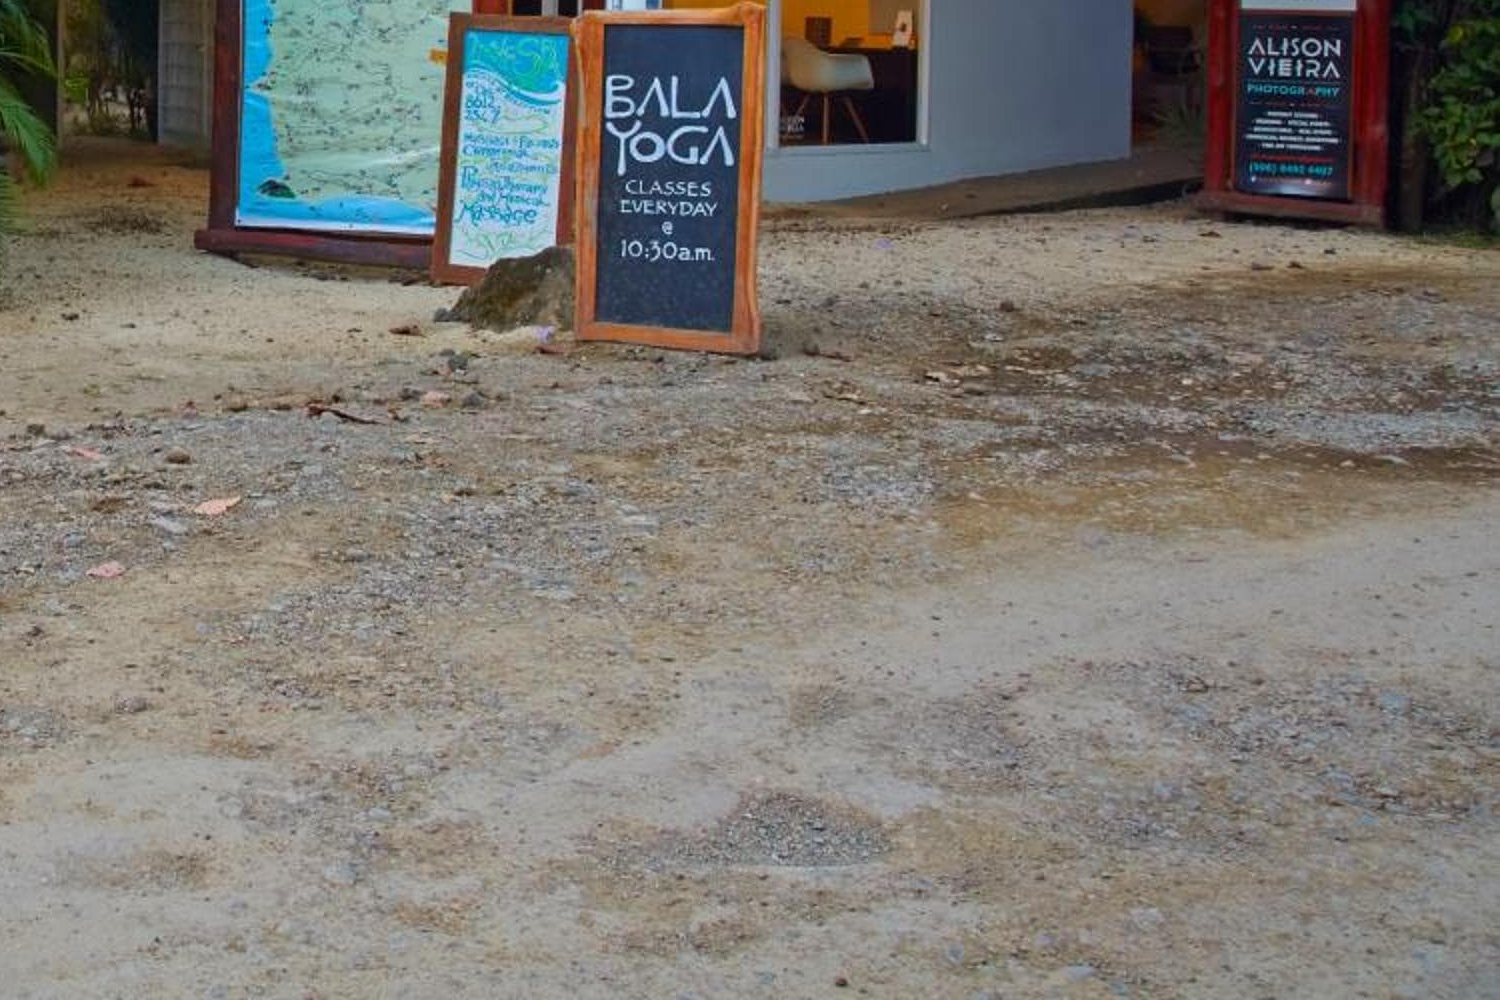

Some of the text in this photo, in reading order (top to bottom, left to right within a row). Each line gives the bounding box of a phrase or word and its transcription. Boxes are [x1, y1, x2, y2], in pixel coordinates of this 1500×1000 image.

[1248, 37, 1341, 57] ALISON
[1248, 57, 1340, 78] VIEIRA
[605, 74, 737, 119] BALA
[605, 120, 735, 176] YOGA
[625, 179, 711, 198] CLASSES
[620, 199, 718, 217] EVERYDAY
